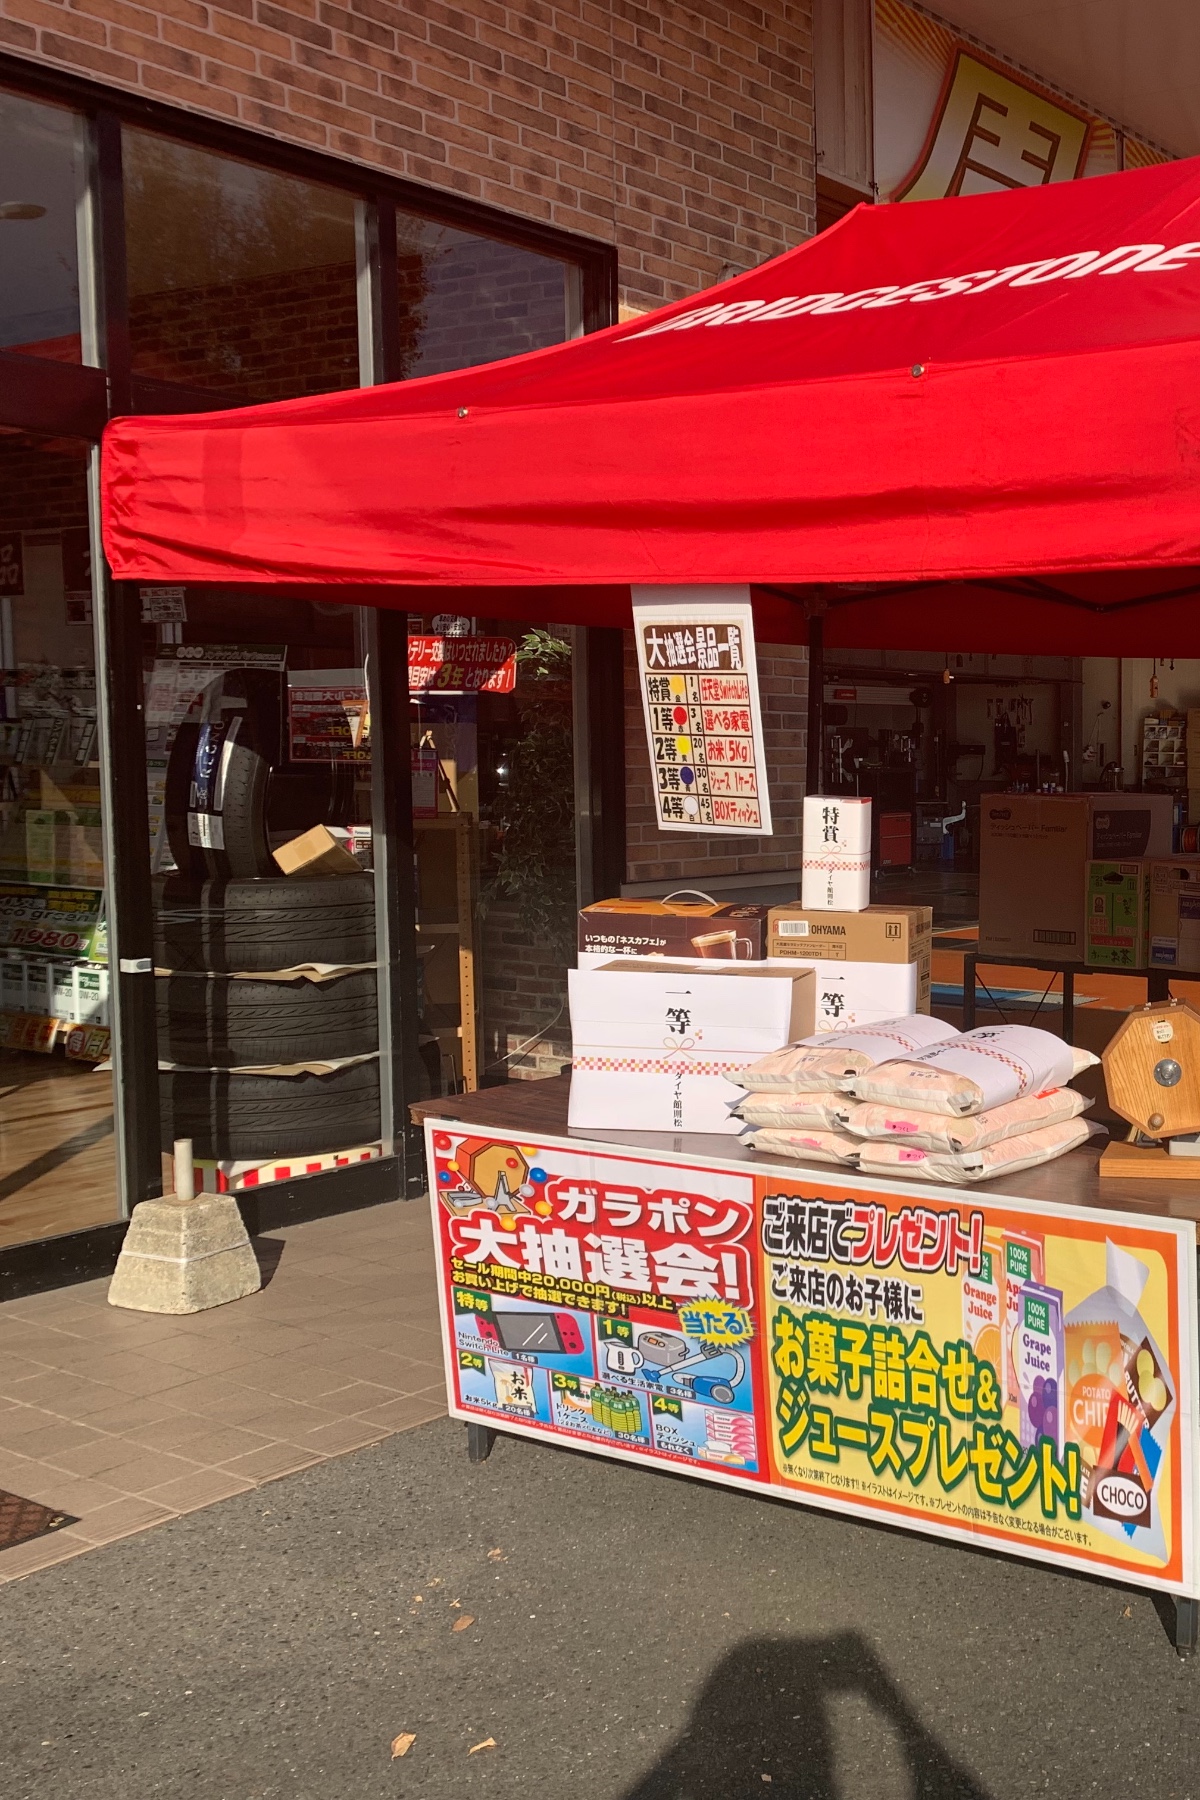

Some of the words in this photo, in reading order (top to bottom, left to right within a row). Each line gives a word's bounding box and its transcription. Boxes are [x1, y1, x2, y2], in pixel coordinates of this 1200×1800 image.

[646, 626, 743, 670] 大抽選会景品一覧
[648, 676, 671, 702] 特賞
[653, 706, 674, 732] 1等
[704, 709, 750, 733] 選べる家電
[656, 737, 677, 761] 2等
[693, 738, 703, 749] 20
[659, 767, 680, 791] 3等
[696, 767, 707, 778] 30
[662, 796, 684, 820] 4等
[700, 797, 710, 809] 45
[713, 801, 759, 824] BOXティッシュ
[822, 806, 840, 844] 特賞
[811, 924, 847, 936] OHYAMA
[585, 933, 667, 947] いつもの「ネスカフェ」が
[820, 976, 846, 1018] 一等
[665, 990, 692, 1034] 一等
[557, 1186, 740, 1237] ガラポン
[764, 1202, 982, 1275] ご来店でプレゼント!
[458, 1222, 741, 1301] 大抽選会!
[1009, 1245, 1028, 1262] 100%
[1010, 1261, 1027, 1276] PURE
[452, 1270, 627, 1316] お買い上げで抽選できます!
[457, 1291, 489, 1312] 特等
[771, 1265, 924, 1321] ご来店のお子様に
[963, 1281, 997, 1305] Orange
[968, 1303, 993, 1321] Juice
[1027, 1301, 1046, 1318] 100%
[602, 1319, 629, 1338] 1等
[682, 1310, 750, 1336] 当たる!
[1027, 1315, 1046, 1330] PURE
[458, 1331, 499, 1347] Nintendo
[459, 1339, 490, 1353] Switch
[492, 1346, 510, 1356] Lite
[1023, 1333, 1052, 1356] Grape
[461, 1352, 483, 1369] 2等
[515, 1353, 535, 1363] 1名様
[775, 1317, 998, 1413] お菓子詰合せ&
[1025, 1354, 1050, 1372] Juice
[511, 1371, 528, 1401] お米
[554, 1373, 577, 1390] 3等
[601, 1372, 664, 1393] 選べる生活家電
[669, 1387, 693, 1399] 3名様
[1082, 1386, 1111, 1400] POTATO
[505, 1405, 531, 1417] 20名様
[556, 1403, 585, 1415] ドリンク
[654, 1397, 679, 1414] 4等
[557, 1411, 588, 1424] 1ケース
[618, 1431, 646, 1444] 30名様
[656, 1424, 678, 1435] BOX
[656, 1432, 697, 1447] ティッシュ
[660, 1442, 690, 1455] もれなく
[779, 1386, 1081, 1515] ジュースプレゼント!
[1102, 1484, 1144, 1510] CHOCO
